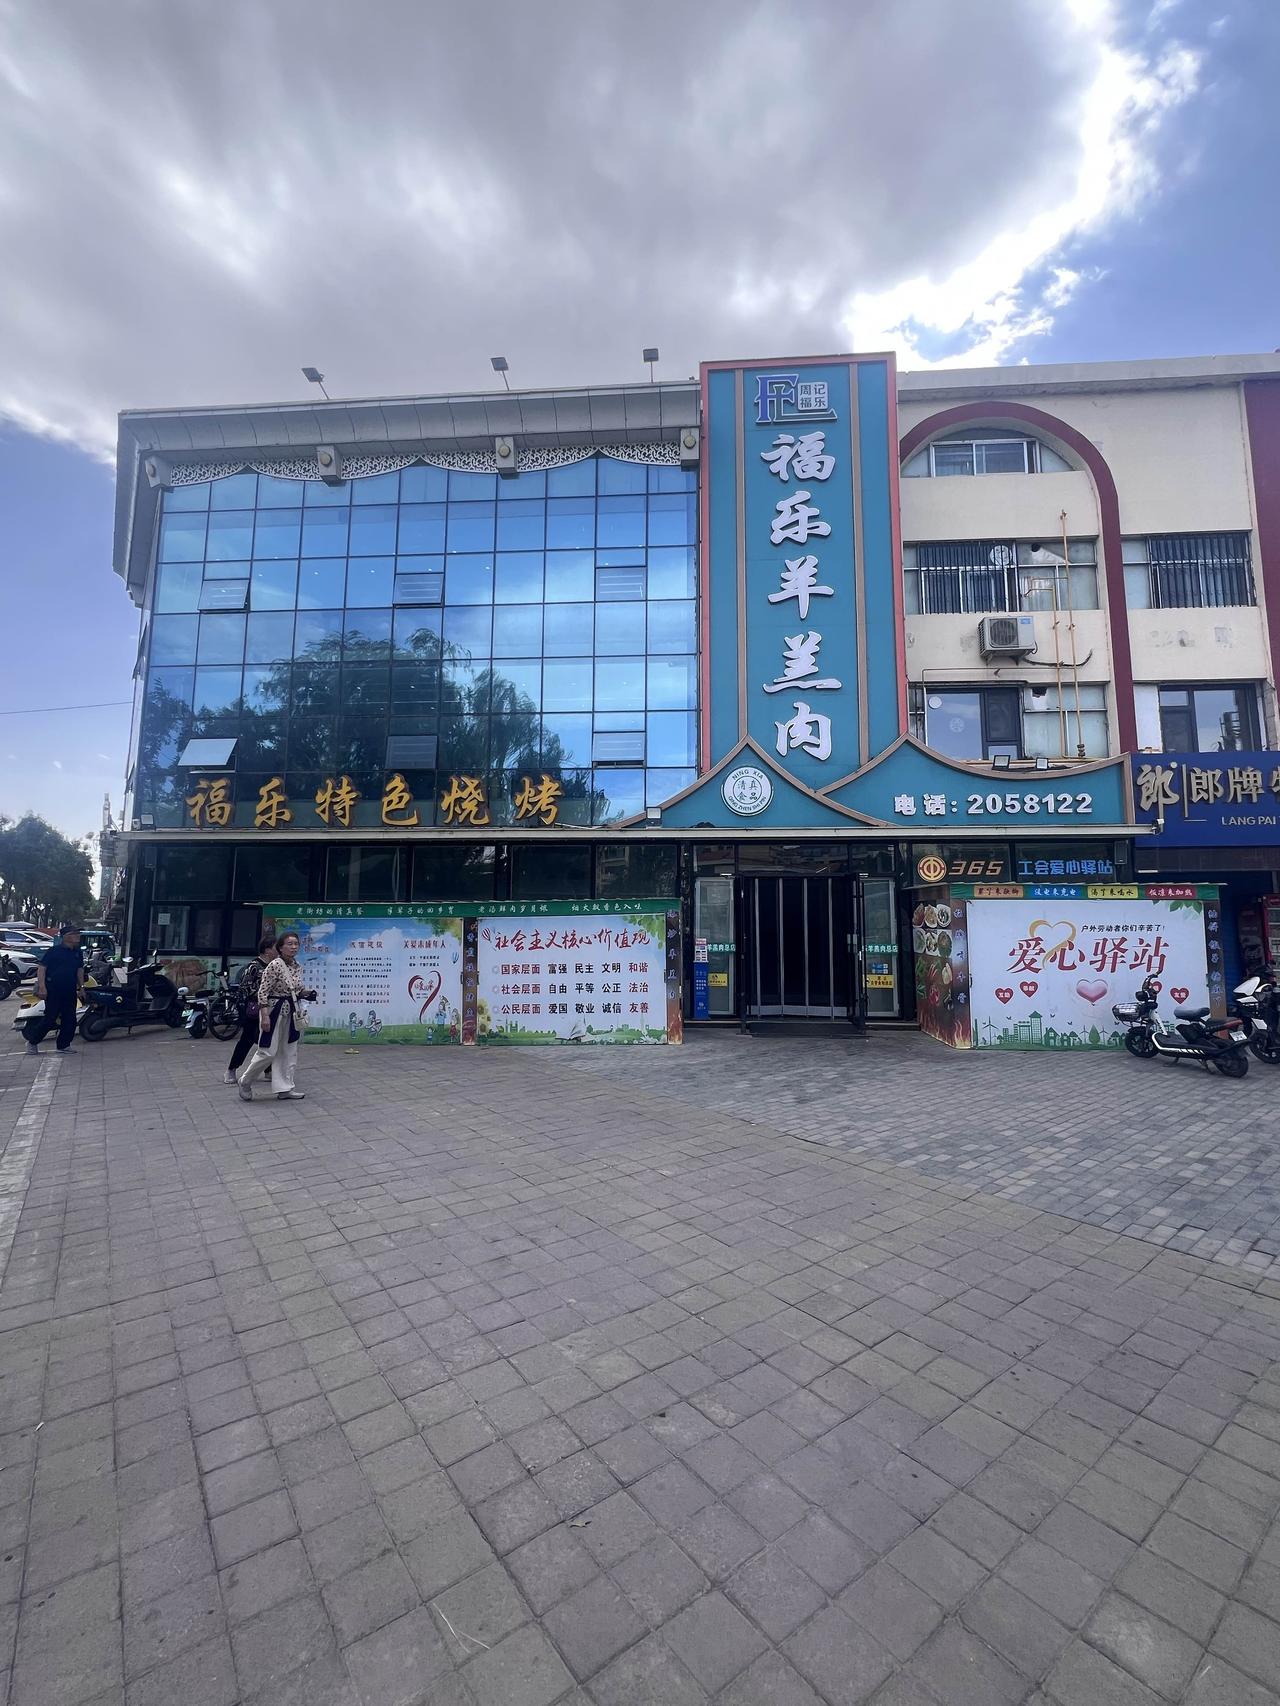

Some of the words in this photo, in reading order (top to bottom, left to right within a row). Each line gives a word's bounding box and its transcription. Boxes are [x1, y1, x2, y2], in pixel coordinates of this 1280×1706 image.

[800, 384, 826, 395] 周记
[800, 396, 826, 408] 福乐
[732, 769, 749, 780] NING
[753, 769, 764, 780] XIA
[186, 775, 563, 828] 福乐特色烧烤
[728, 795, 739, 807] QING
[967, 793, 1093, 814] 2058122
[1221, 816, 1256, 826] LANG
[1258, 816, 1276, 825] PAI
[949, 860, 1004, 875] 365
[1018, 859, 1113, 875] 工会爱心驿站
[1090, 887, 1134, 897] 渴了来喝水
[495, 928, 651, 951] 社会主义核心价值观
[1006, 936, 1169, 974] 爱心驿站
[501, 964, 540, 975] 国家层面
[548, 963, 567, 975] 富强
[575, 963, 594, 974] 民主
[602, 963, 621, 973] 文明
[629, 962, 649, 973] 和谐
[501, 984, 541, 995] 社会层面
[549, 983, 567, 994] 自由
[575, 983, 594, 994] 平等
[602, 983, 622, 993] 公正
[629, 982, 649, 993] 法治
[501, 1004, 541, 1015] 公民层面
[548, 1003, 568, 1014] 爱国
[575, 1003, 594, 1014] 敬业
[602, 1003, 622, 1014] 诚信
[629, 1002, 650, 1013] 友善
